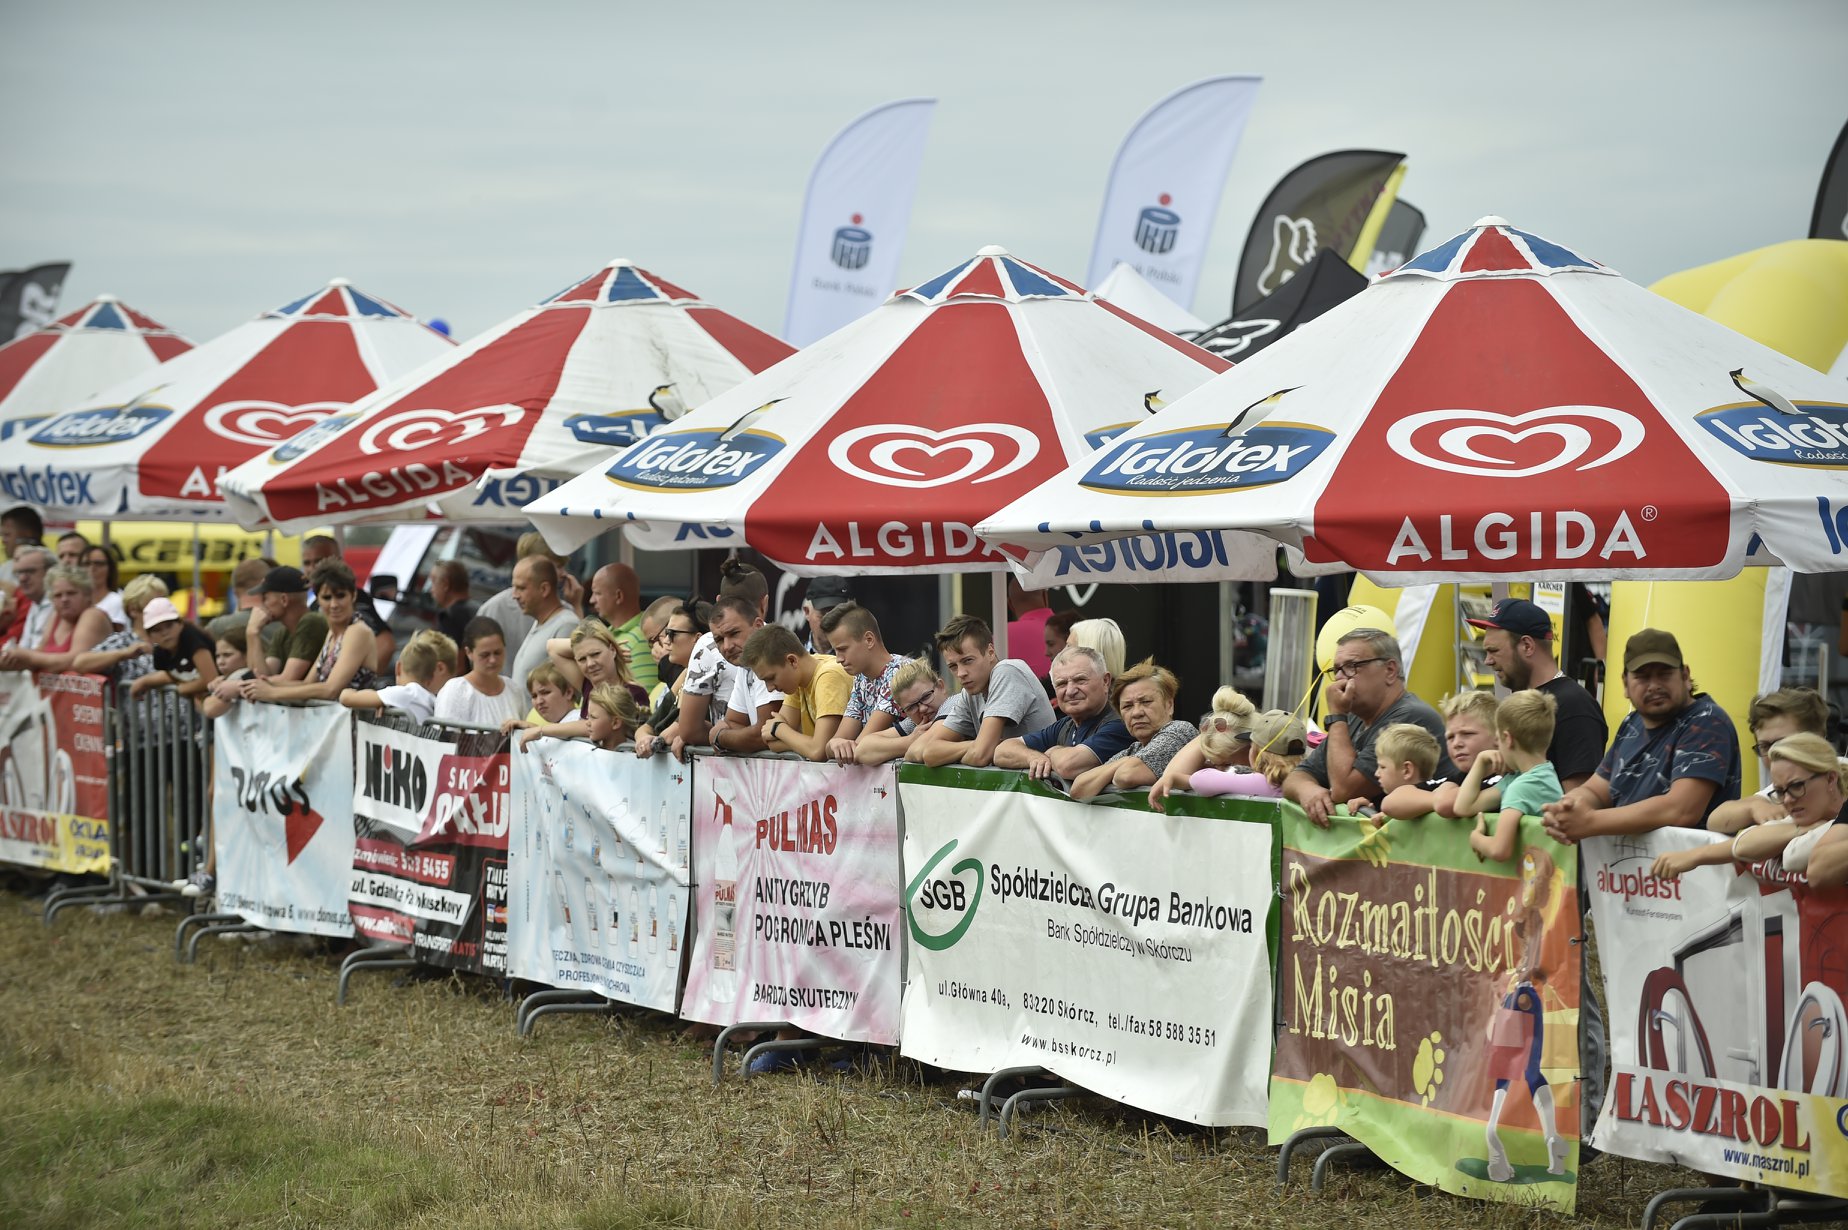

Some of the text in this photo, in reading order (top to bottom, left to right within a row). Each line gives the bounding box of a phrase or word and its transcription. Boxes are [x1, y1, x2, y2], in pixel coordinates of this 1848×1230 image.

[1711, 416, 1848, 451] Iglot
[622, 438, 766, 477] Iglotex
[1099, 439, 1312, 475] Iglotex
[315, 459, 474, 511] ALGIDA
[1386, 509, 1647, 566] ALGIDA
[756, 794, 838, 856] PULMAS
[755, 877, 831, 909] ANTYGRZYB
[920, 879, 966, 911] SGB
[990, 863, 1253, 934] Spółdzielcza Grupa Bankowa
[1597, 862, 1682, 902] aluplast
[755, 913, 828, 947] POGROMCA
[829, 915, 891, 951] PLEŚNI
[1047, 918, 1071, 942] Bank
[1073, 923, 1135, 957] Spółdzielczy
[1145, 937, 1193, 963] Skórczu
[753, 982, 859, 1011] BARDZO SKUTECZNY
[1289, 952, 1397, 1051] Misia
[1108, 1011, 1146, 1035] tel./fax
[1148, 1019, 1162, 1038] 58
[1165, 1022, 1184, 1042] 588
[1188, 1025, 1201, 1045] 35
[1204, 1028, 1216, 1047] 51
[1723, 1146, 1811, 1179] www.maszrol.pl
